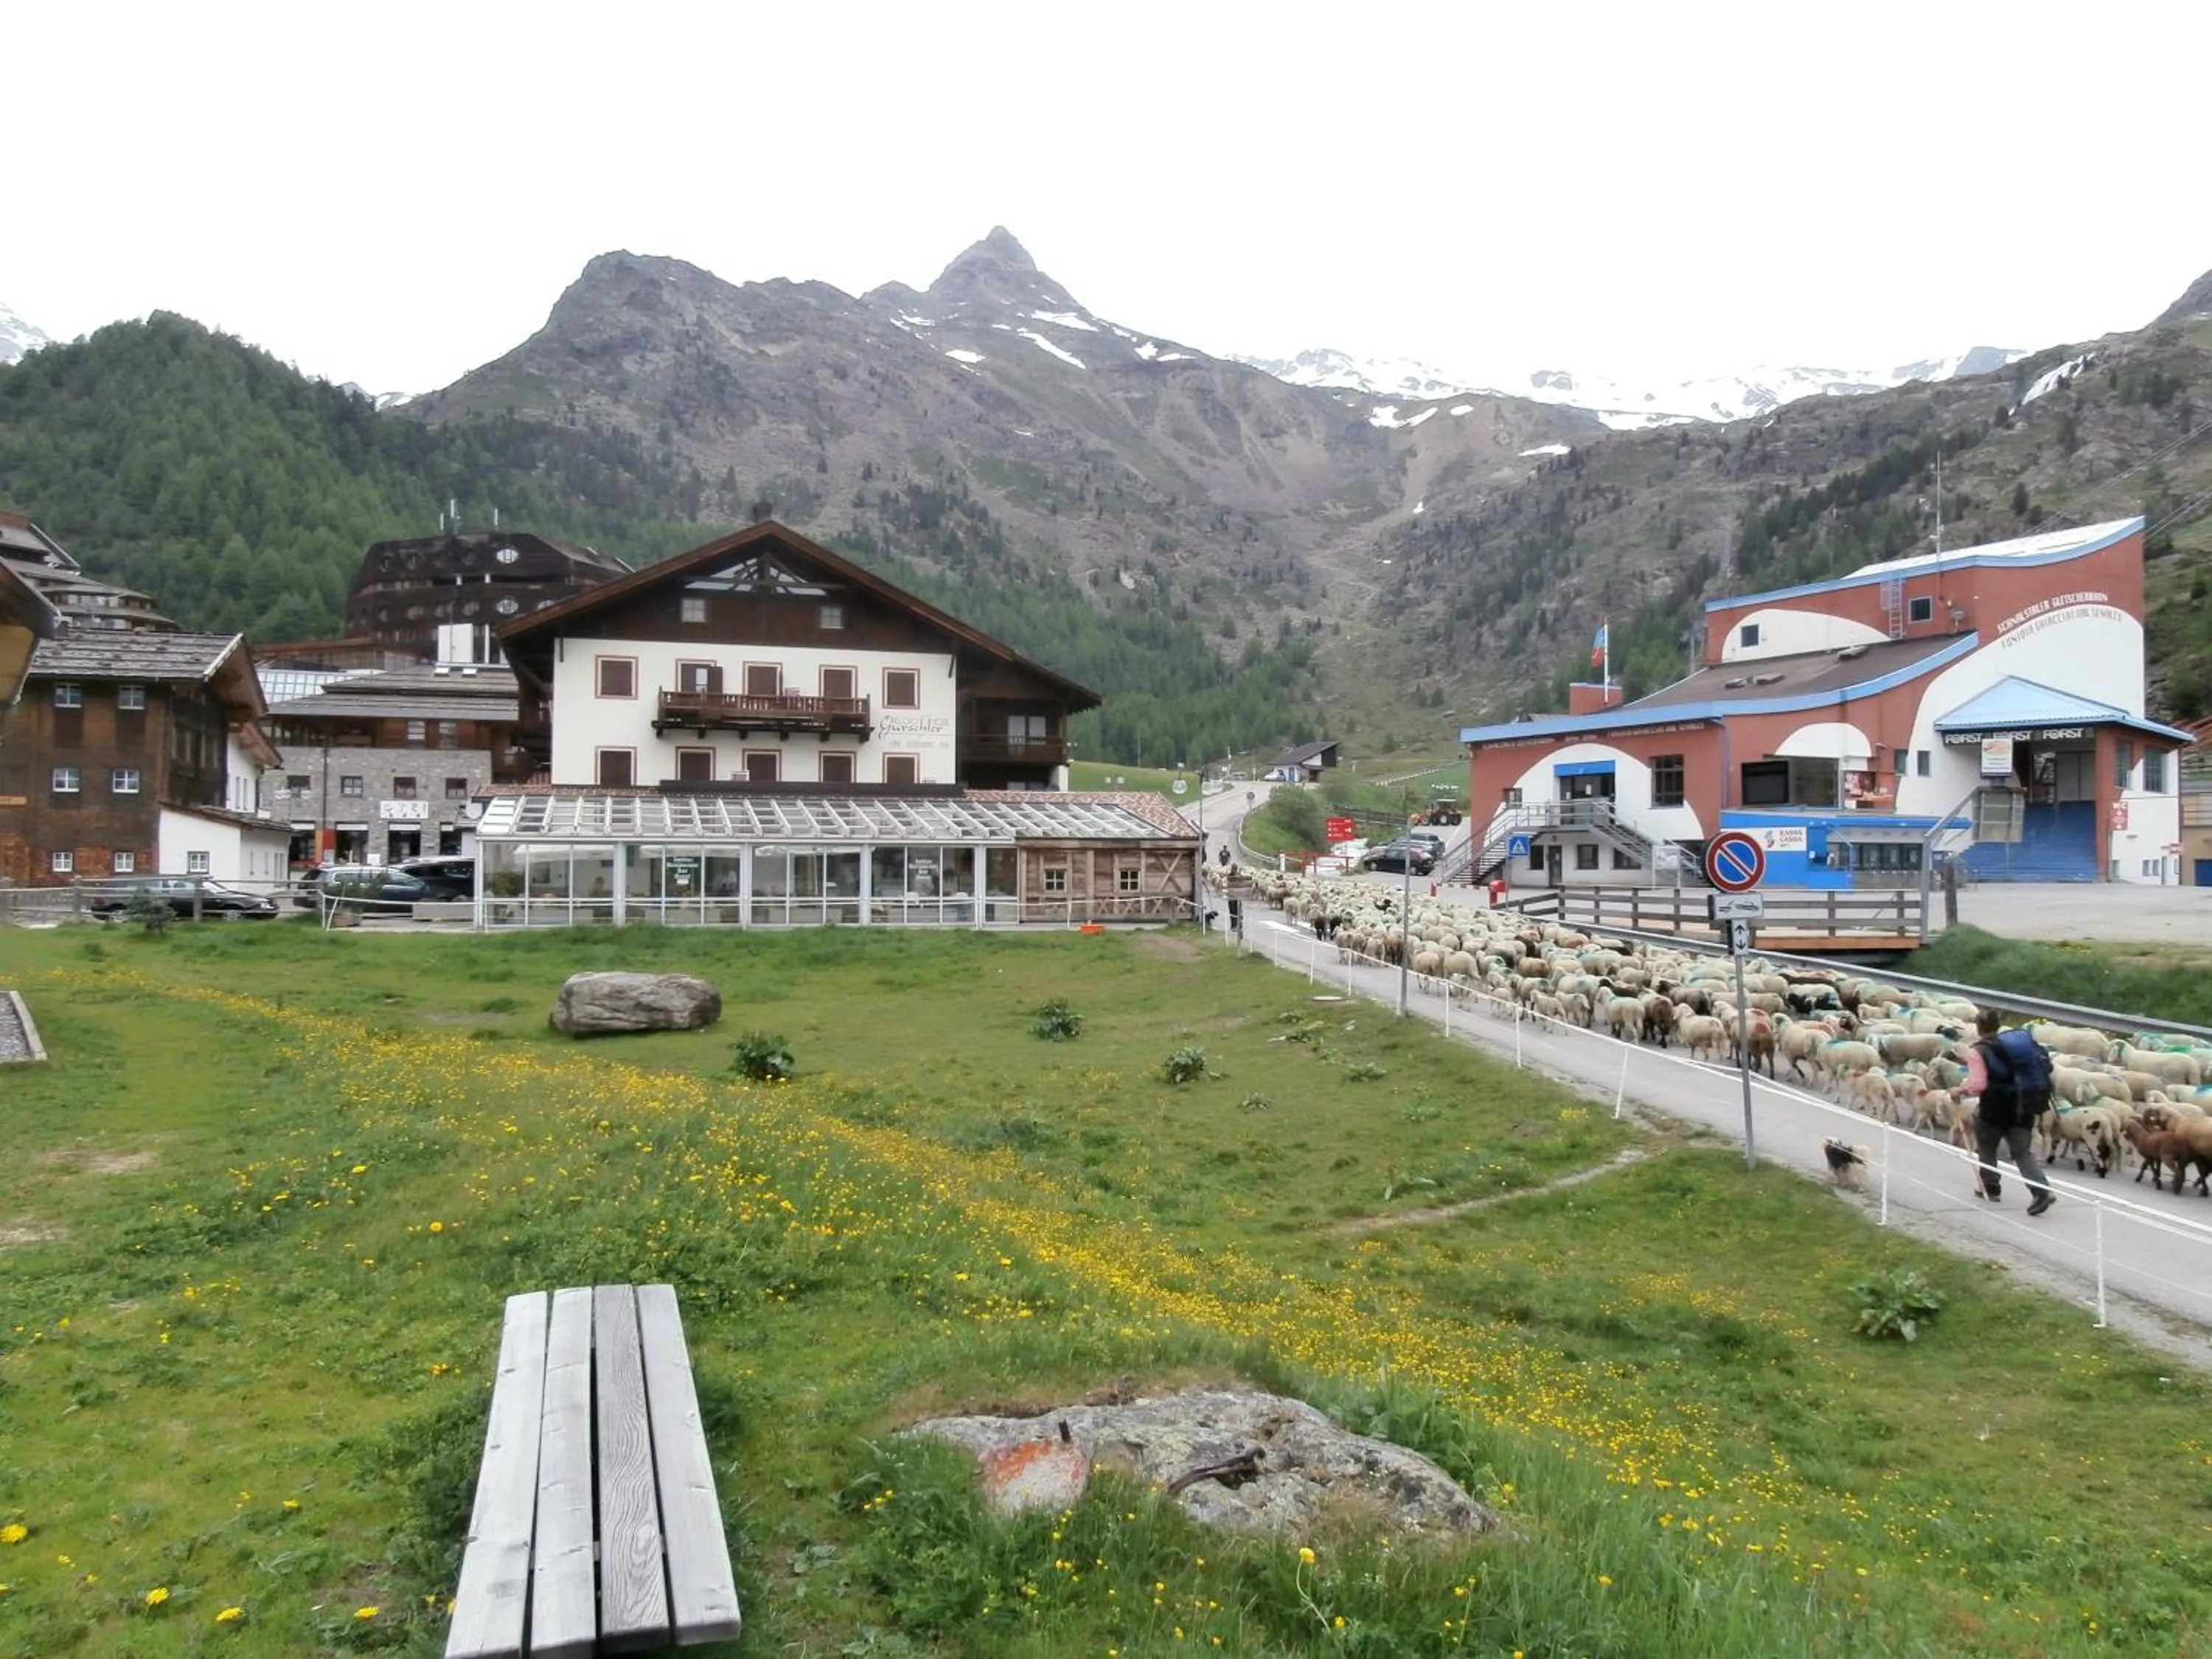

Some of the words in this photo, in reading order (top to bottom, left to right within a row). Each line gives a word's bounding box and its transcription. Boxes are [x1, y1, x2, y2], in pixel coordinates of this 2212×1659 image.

[1945, 733, 1983, 744] FORST
[1993, 731, 2033, 741] FORST
[2043, 728, 2084, 740] FORST
[2112, 801, 2128, 810] WC
